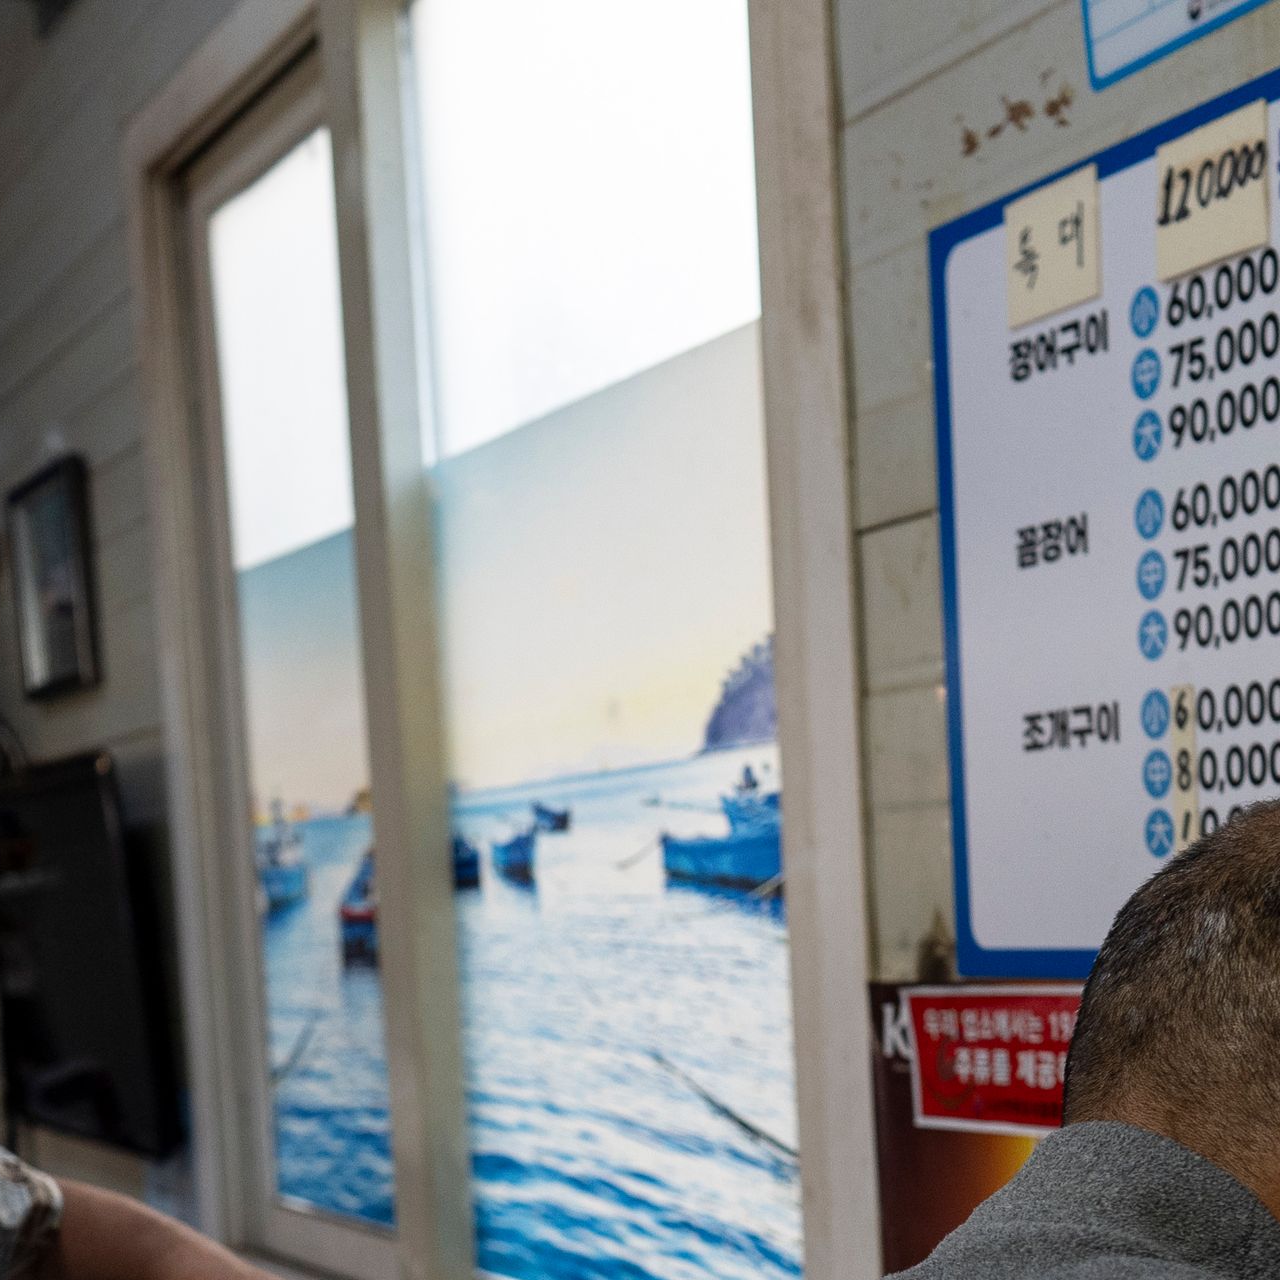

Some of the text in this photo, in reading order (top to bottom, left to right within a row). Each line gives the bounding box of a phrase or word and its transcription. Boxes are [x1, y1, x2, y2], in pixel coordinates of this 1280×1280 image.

[1167, 248, 1279, 326] 60,000
[1009, 308, 1109, 383] 장어구이
[1168, 312, 1279, 389] 75,000
[1017, 512, 1089, 569] 꼼장어
[1023, 701, 1120, 752] 조개구이
